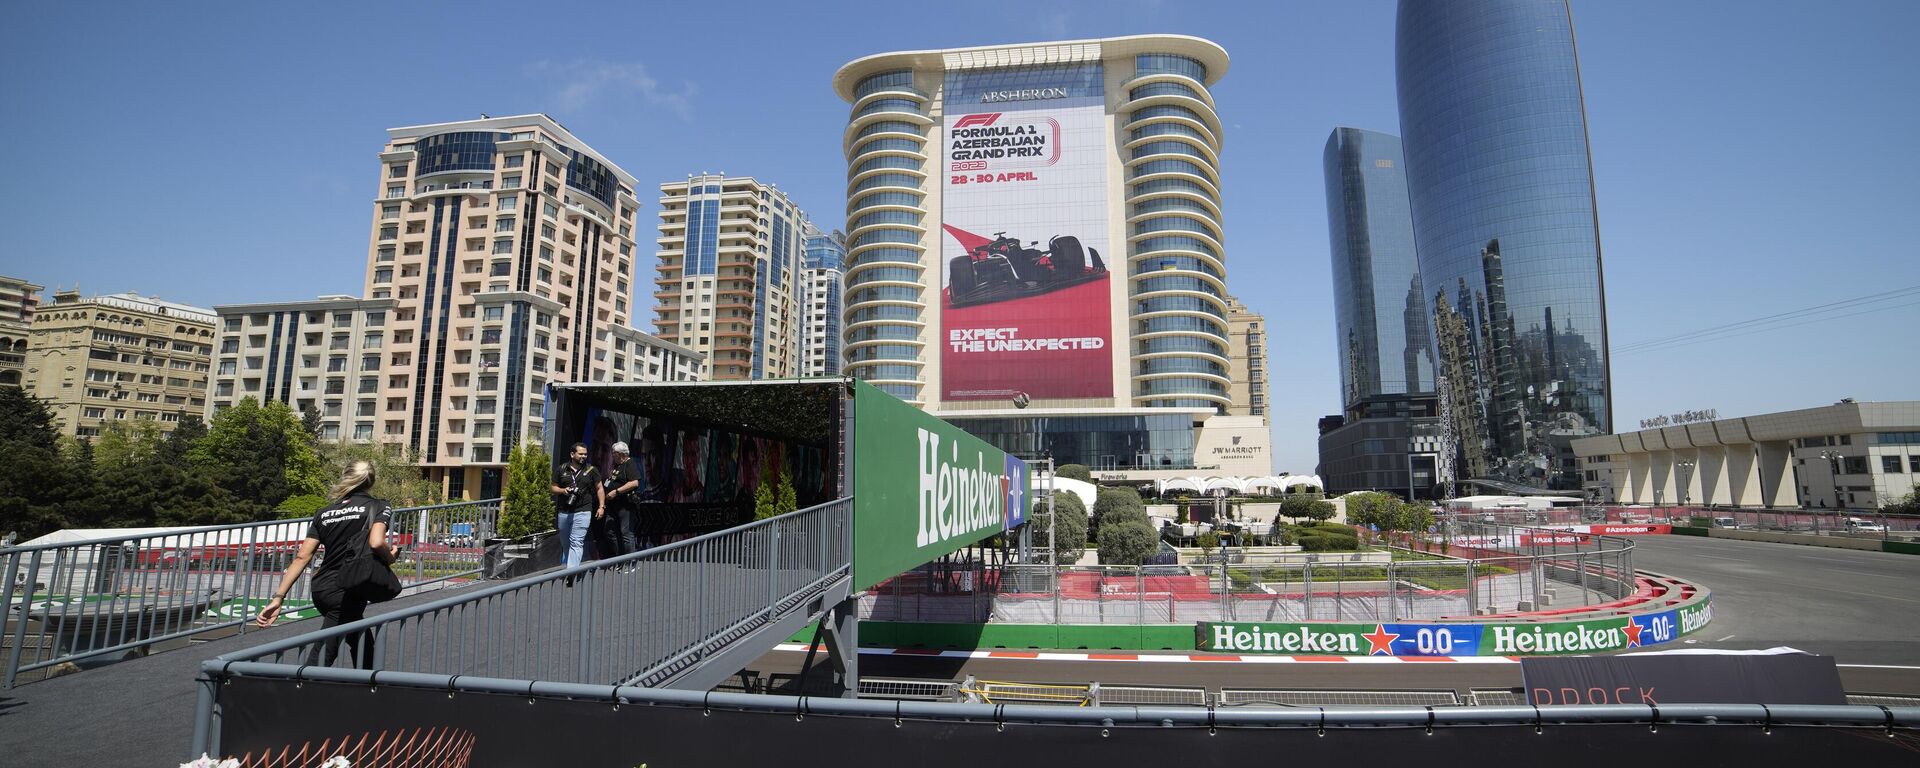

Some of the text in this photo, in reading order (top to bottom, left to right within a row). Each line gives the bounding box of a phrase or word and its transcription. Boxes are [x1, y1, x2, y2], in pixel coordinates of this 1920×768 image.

[981, 87, 1068, 104] ABSHERON
[951, 125, 1037, 139] FORMULA 1
[951, 135, 1046, 150] AZERBAIJAN
[951, 146, 1043, 161] GRAND PRIX
[951, 161, 988, 172] 2023
[951, 175, 968, 185] 28
[976, 174, 994, 183] 30
[996, 172, 1038, 183] APRIL
[950, 327, 1019, 341] EXPECT
[950, 337, 1104, 353] THE UNEXPECTED
[1212, 446, 1262, 455] JW MARRIOTT
[917, 427, 1000, 548] Heineken
[321, 506, 366, 519] PETRONAS
[1680, 603, 1711, 634] Heineken
[1212, 625, 1453, 654] Heineken 0.0
[1492, 615, 1670, 653] Heineken 0.0
